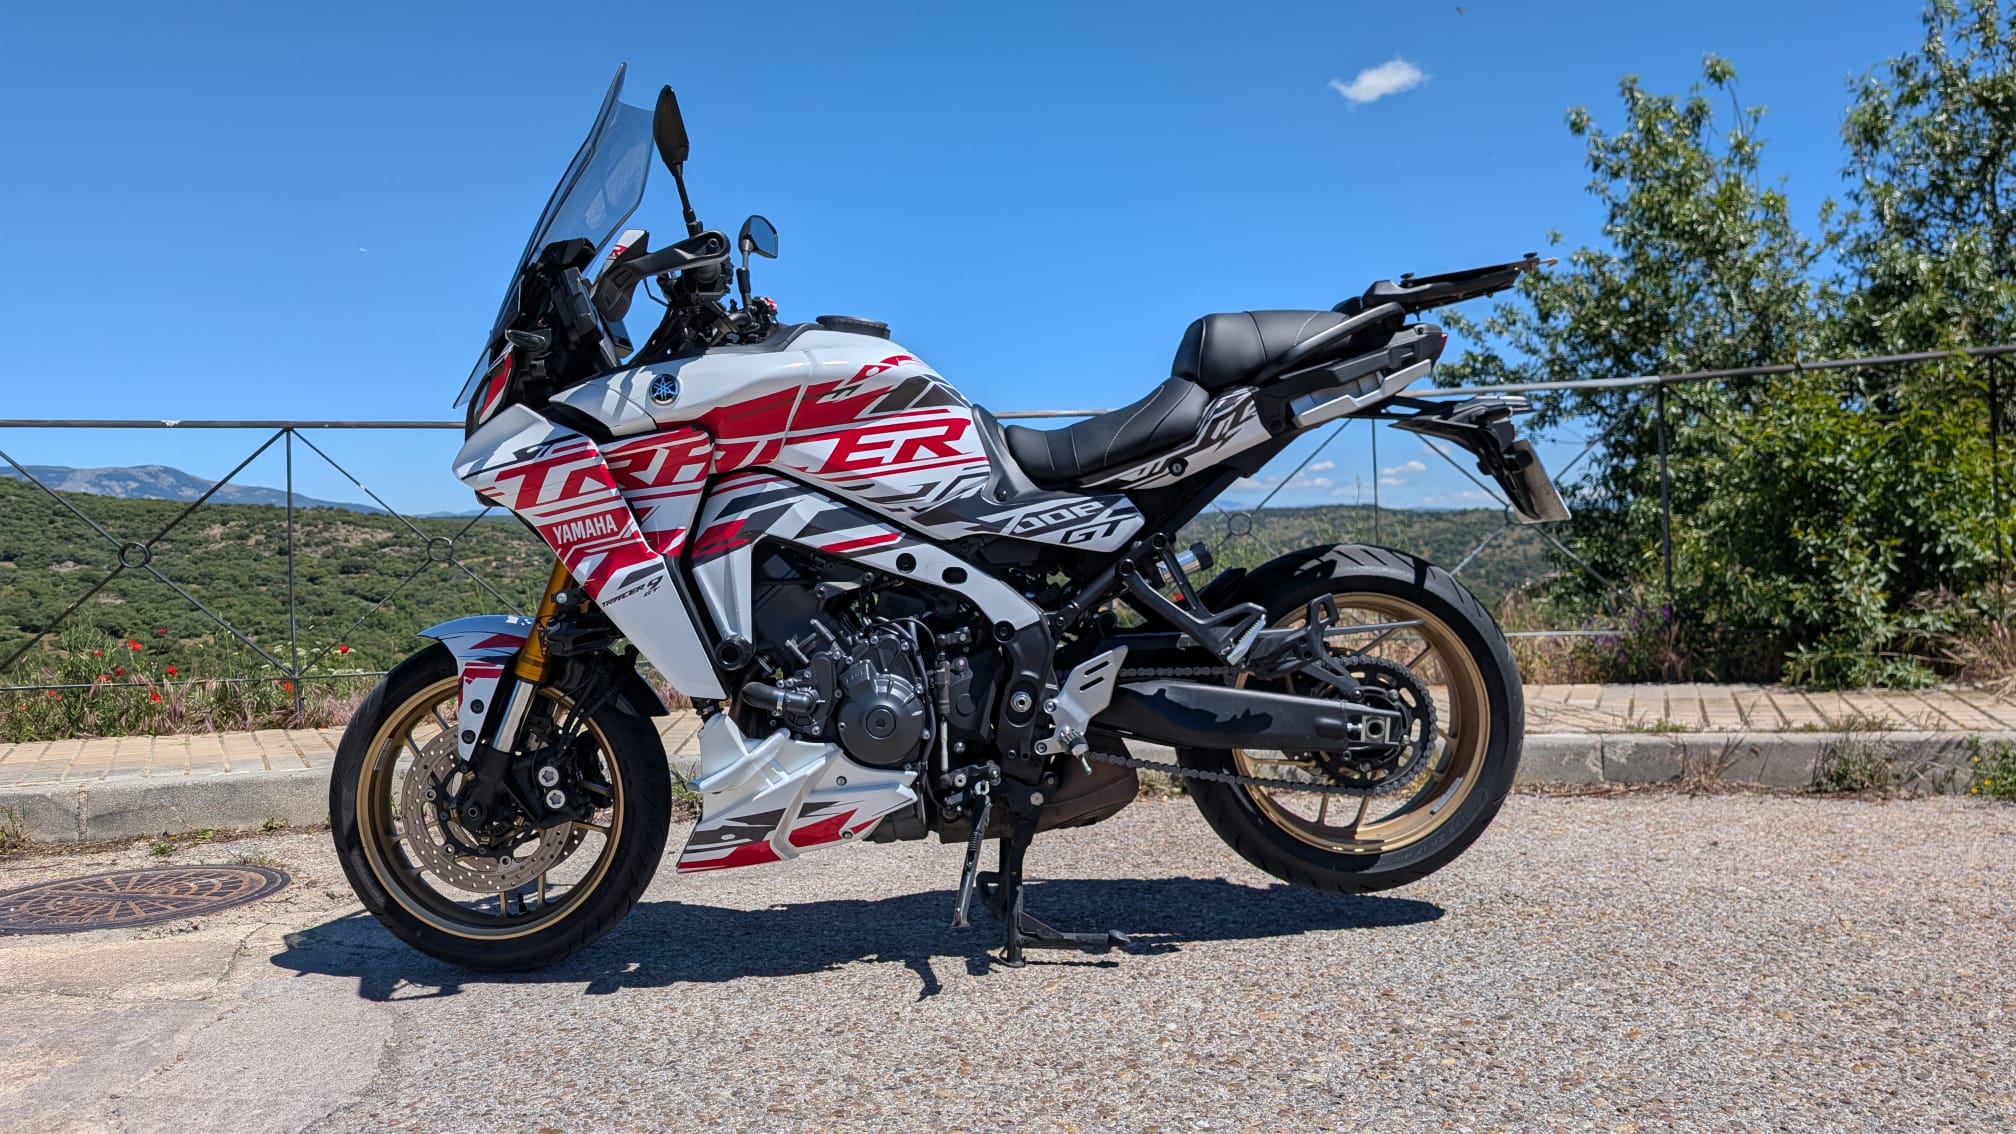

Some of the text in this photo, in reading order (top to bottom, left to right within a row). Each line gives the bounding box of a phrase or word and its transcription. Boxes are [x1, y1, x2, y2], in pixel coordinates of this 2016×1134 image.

[552, 514, 618, 545] YAMAHA
[601, 575, 664, 607] TRACER 9
